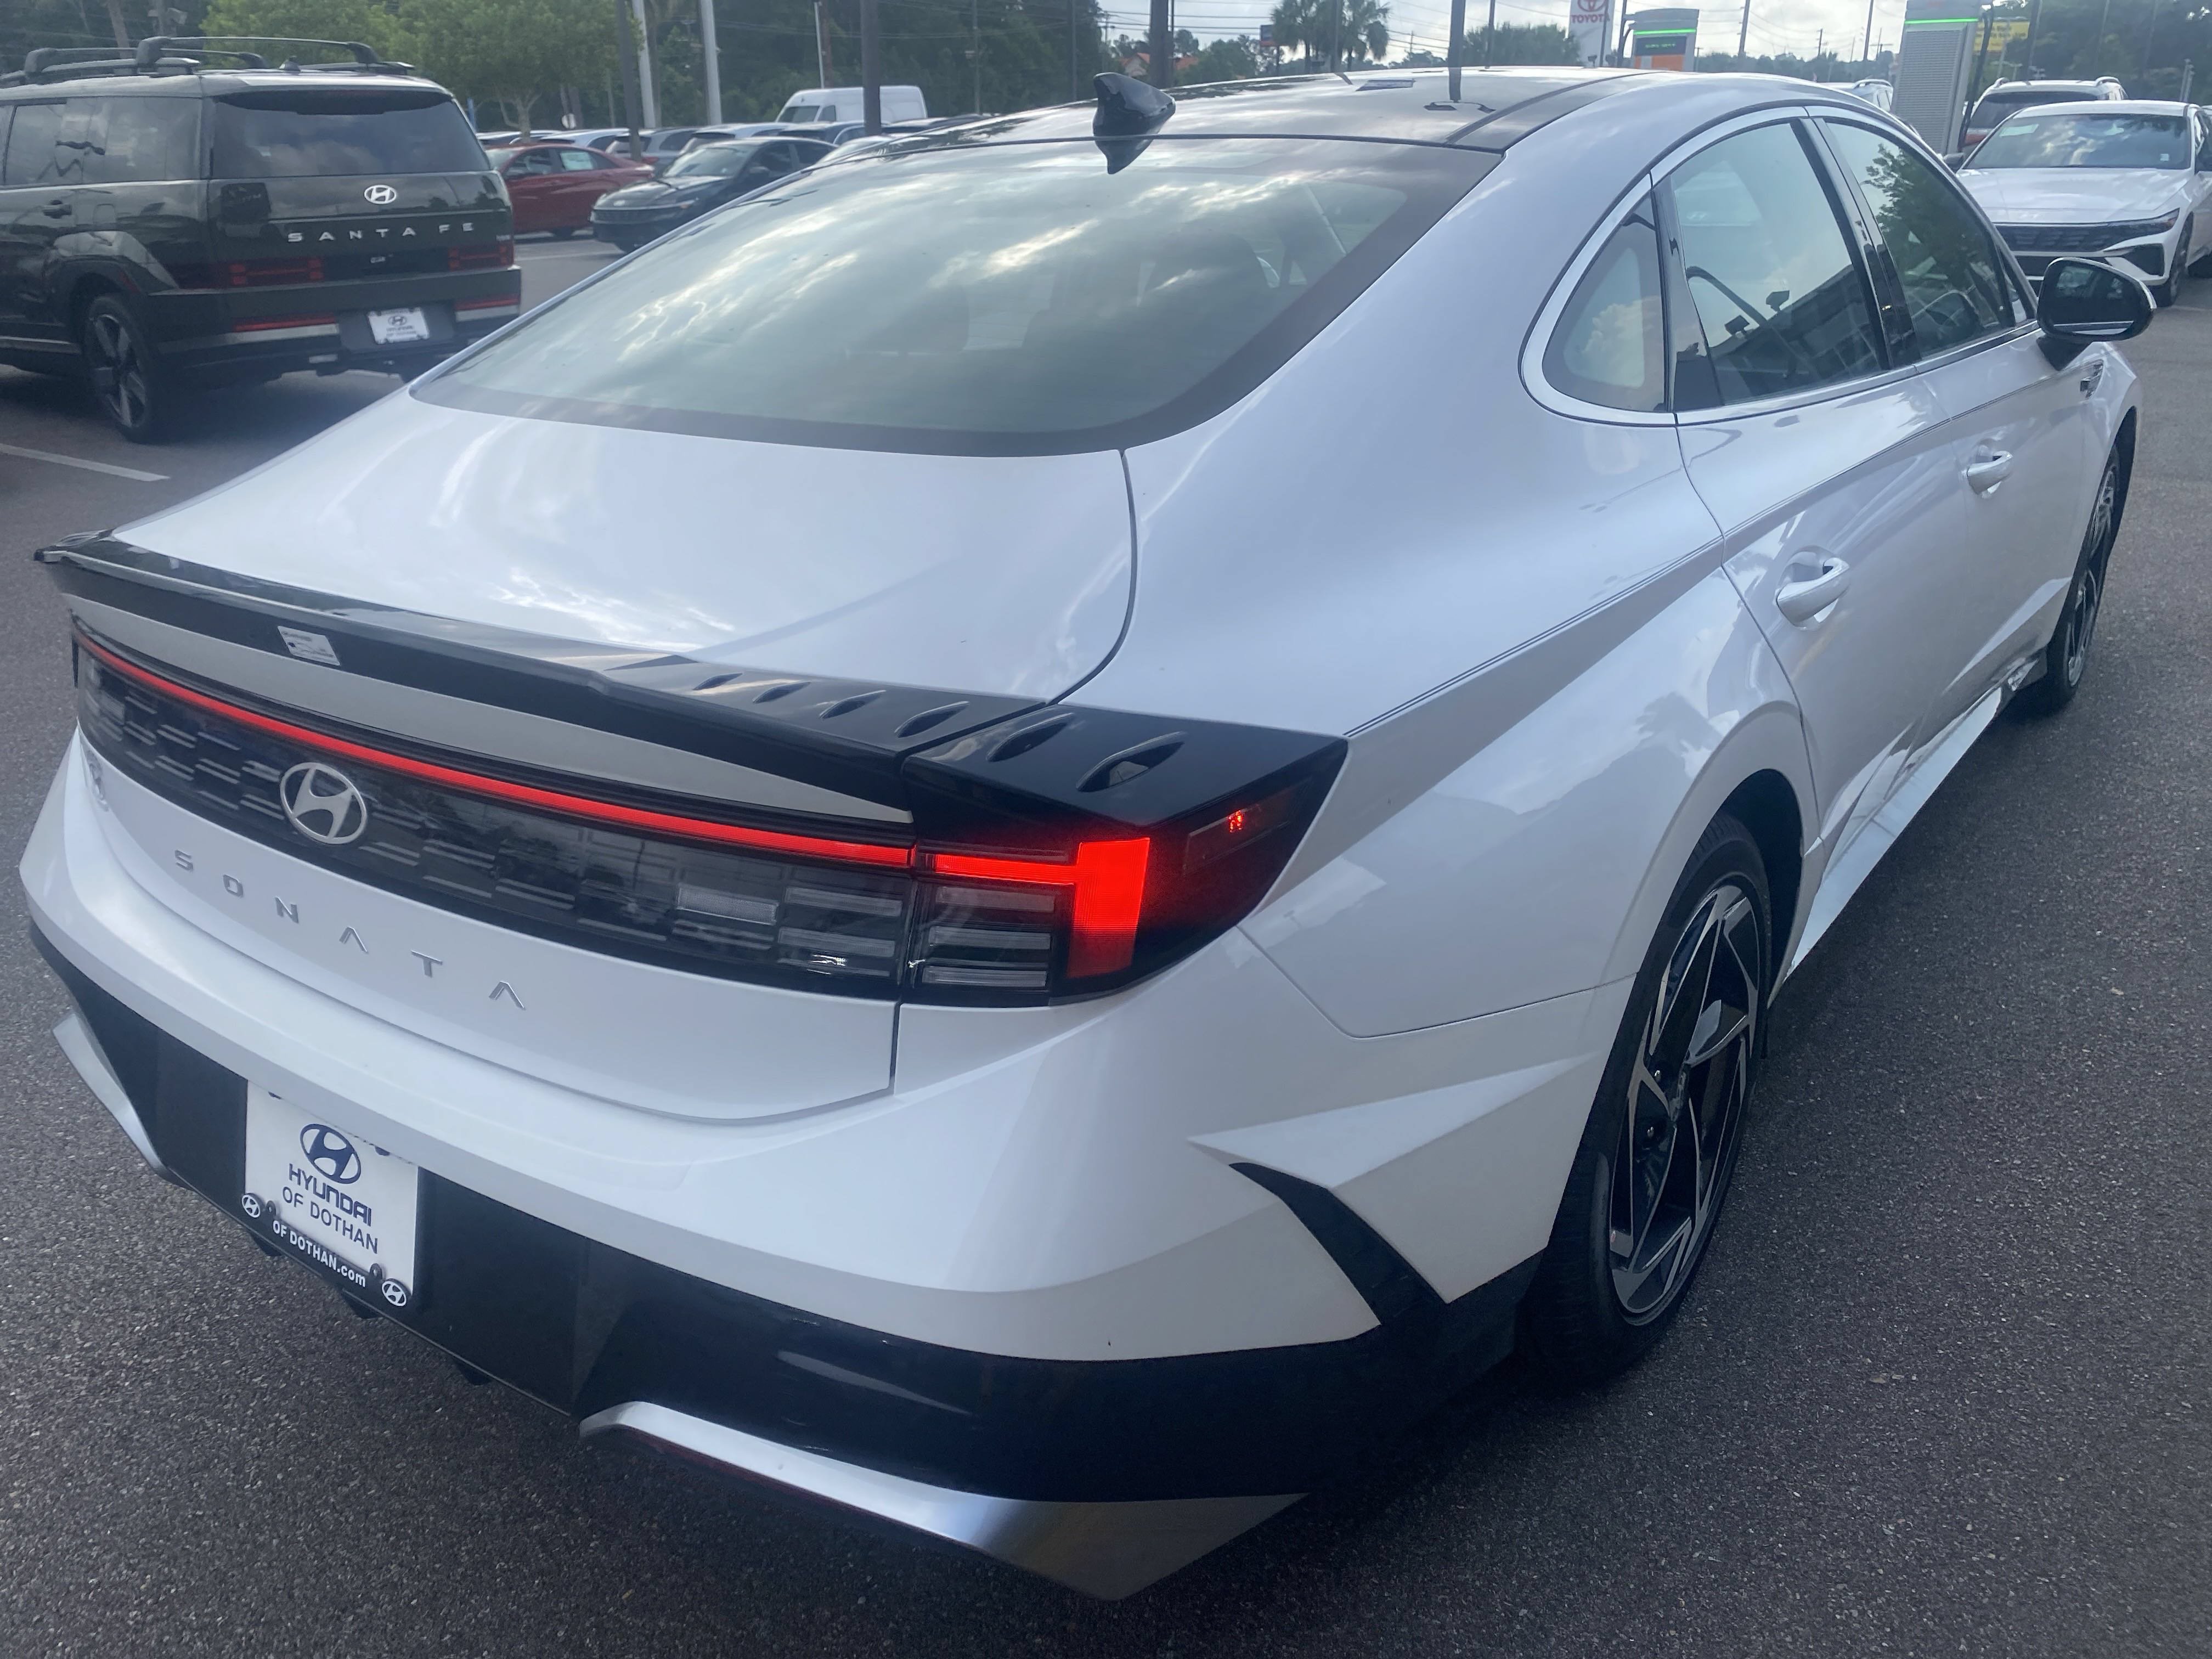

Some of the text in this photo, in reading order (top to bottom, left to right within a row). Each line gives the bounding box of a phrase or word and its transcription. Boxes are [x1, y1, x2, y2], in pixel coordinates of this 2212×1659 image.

[287, 222, 473, 242] SANTA FE
[174, 849, 526, 1011] SONATA
[282, 1186, 379, 1255] OF DOTHAN
[289, 1163, 372, 1227] HYUNDAI
[272, 1220, 366, 1288] OF DOTHAN.com
